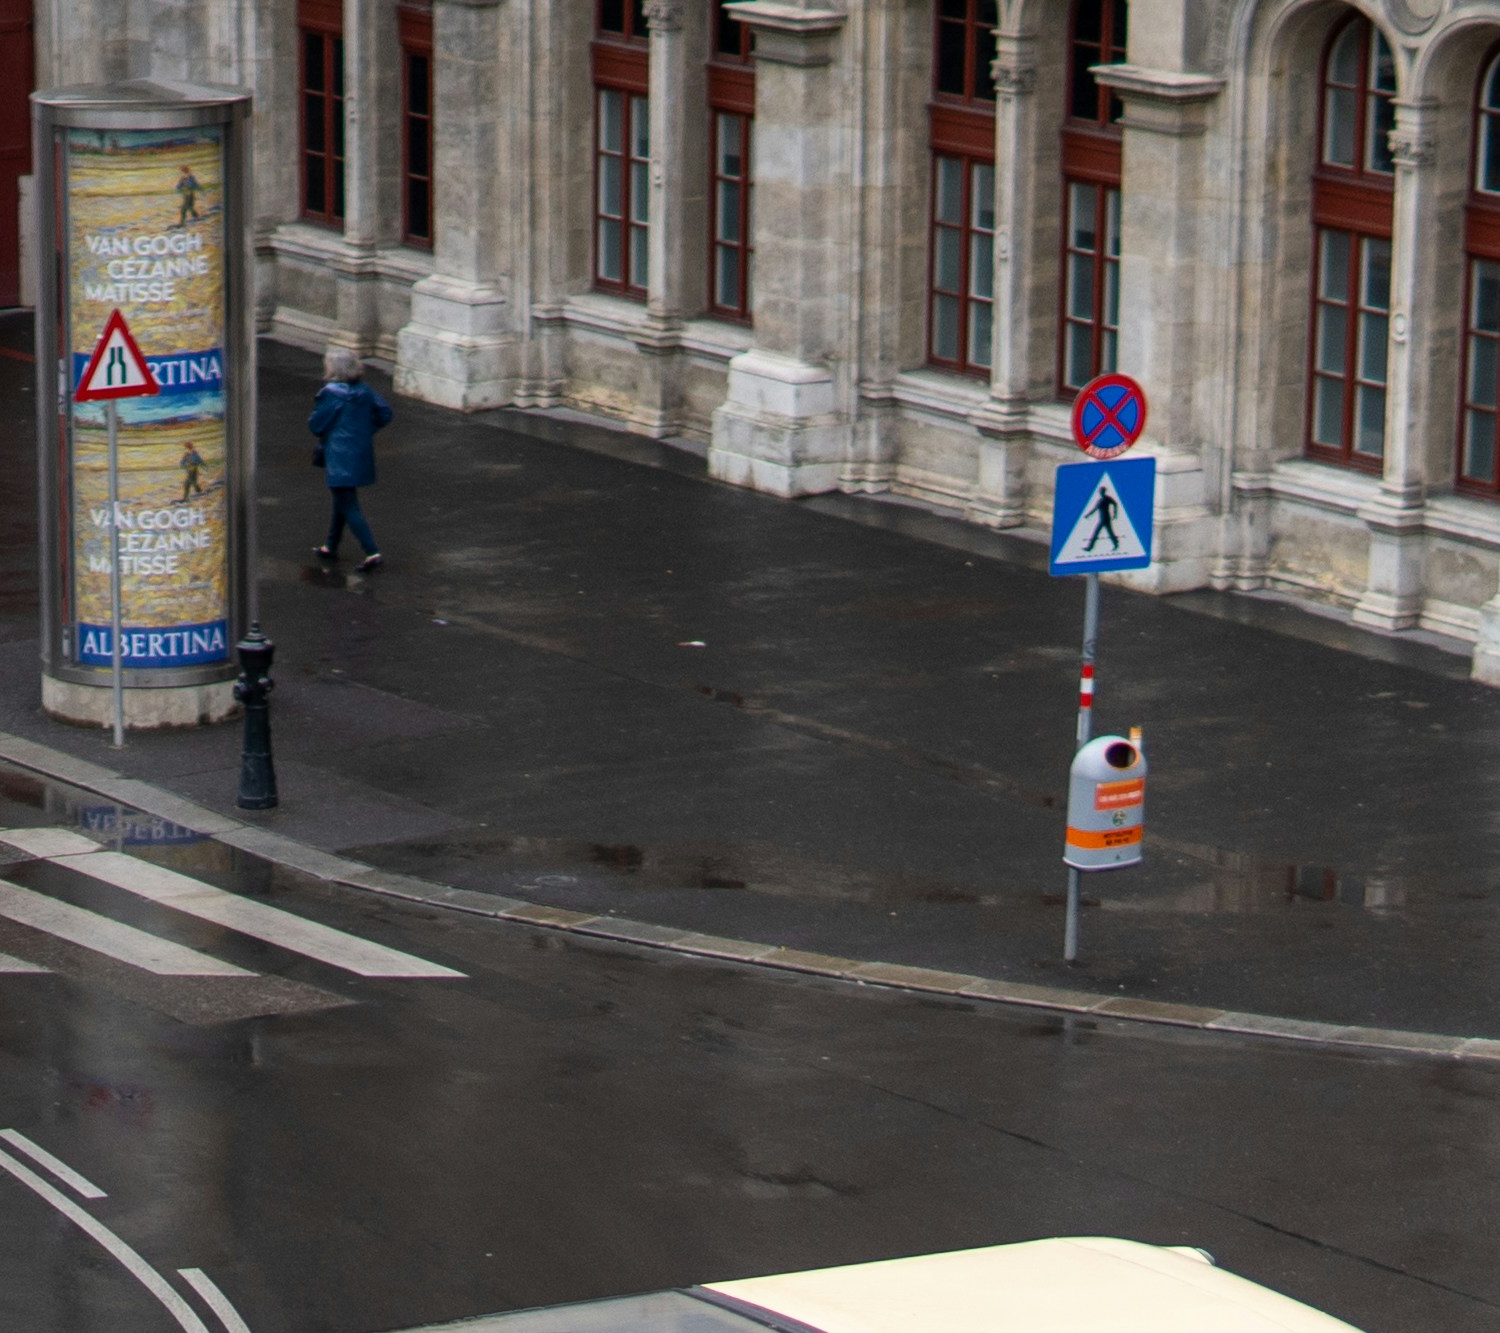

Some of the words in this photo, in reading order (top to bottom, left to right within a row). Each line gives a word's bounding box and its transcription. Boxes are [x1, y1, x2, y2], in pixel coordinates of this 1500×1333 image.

[85, 234, 130, 256] VAN
[134, 233, 203, 255] GOGH
[107, 254, 209, 280] CÉZANNE
[85, 281, 176, 302] MATISSE
[138, 508, 206, 529] GOGH
[118, 529, 212, 553] ÉZANNE
